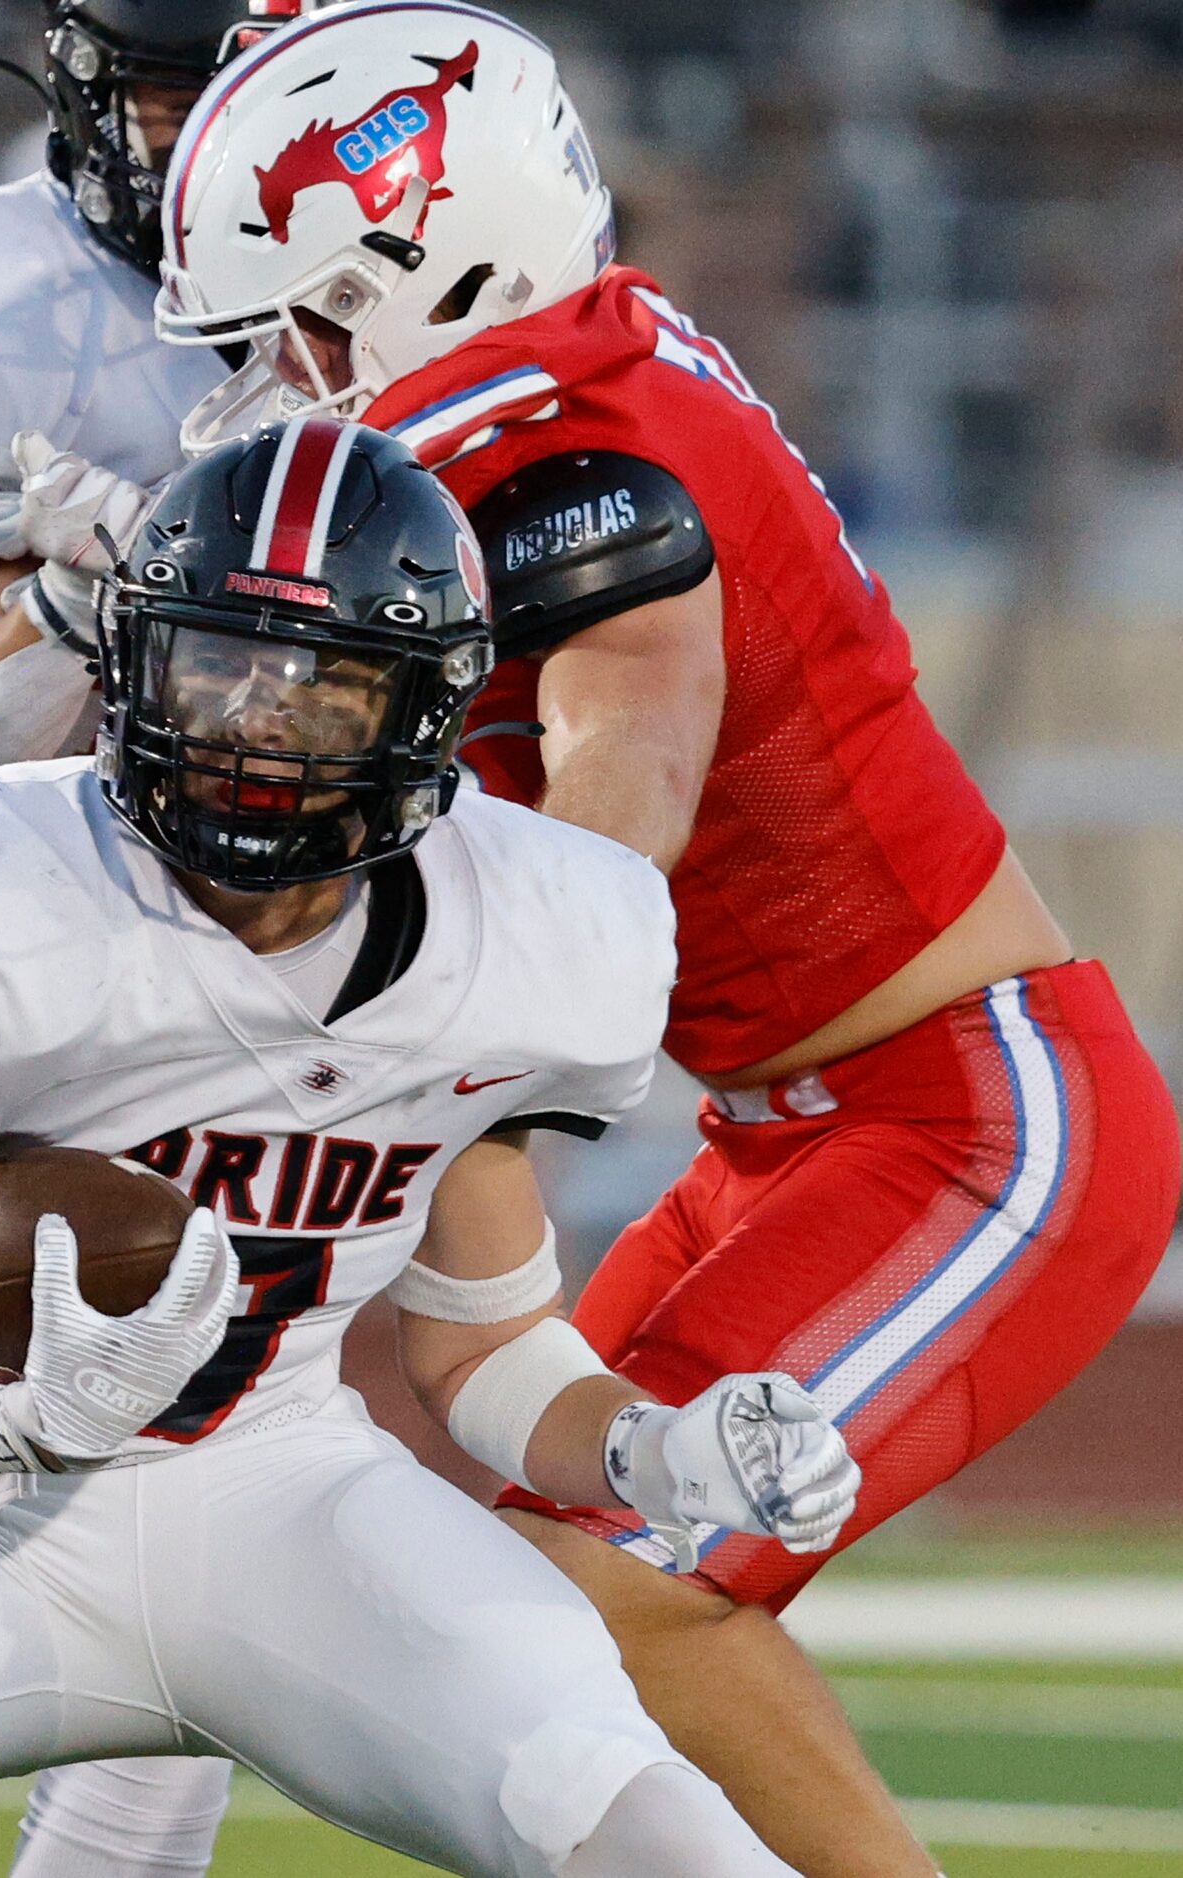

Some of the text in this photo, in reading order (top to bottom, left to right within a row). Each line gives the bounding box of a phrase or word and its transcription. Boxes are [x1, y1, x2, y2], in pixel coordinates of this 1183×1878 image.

[334, 95, 430, 175] GHS
[505, 488, 636, 571] DOUGLAS
[225, 571, 330, 608] PANTHERS
[115, 1127, 443, 1230] PRIDE
